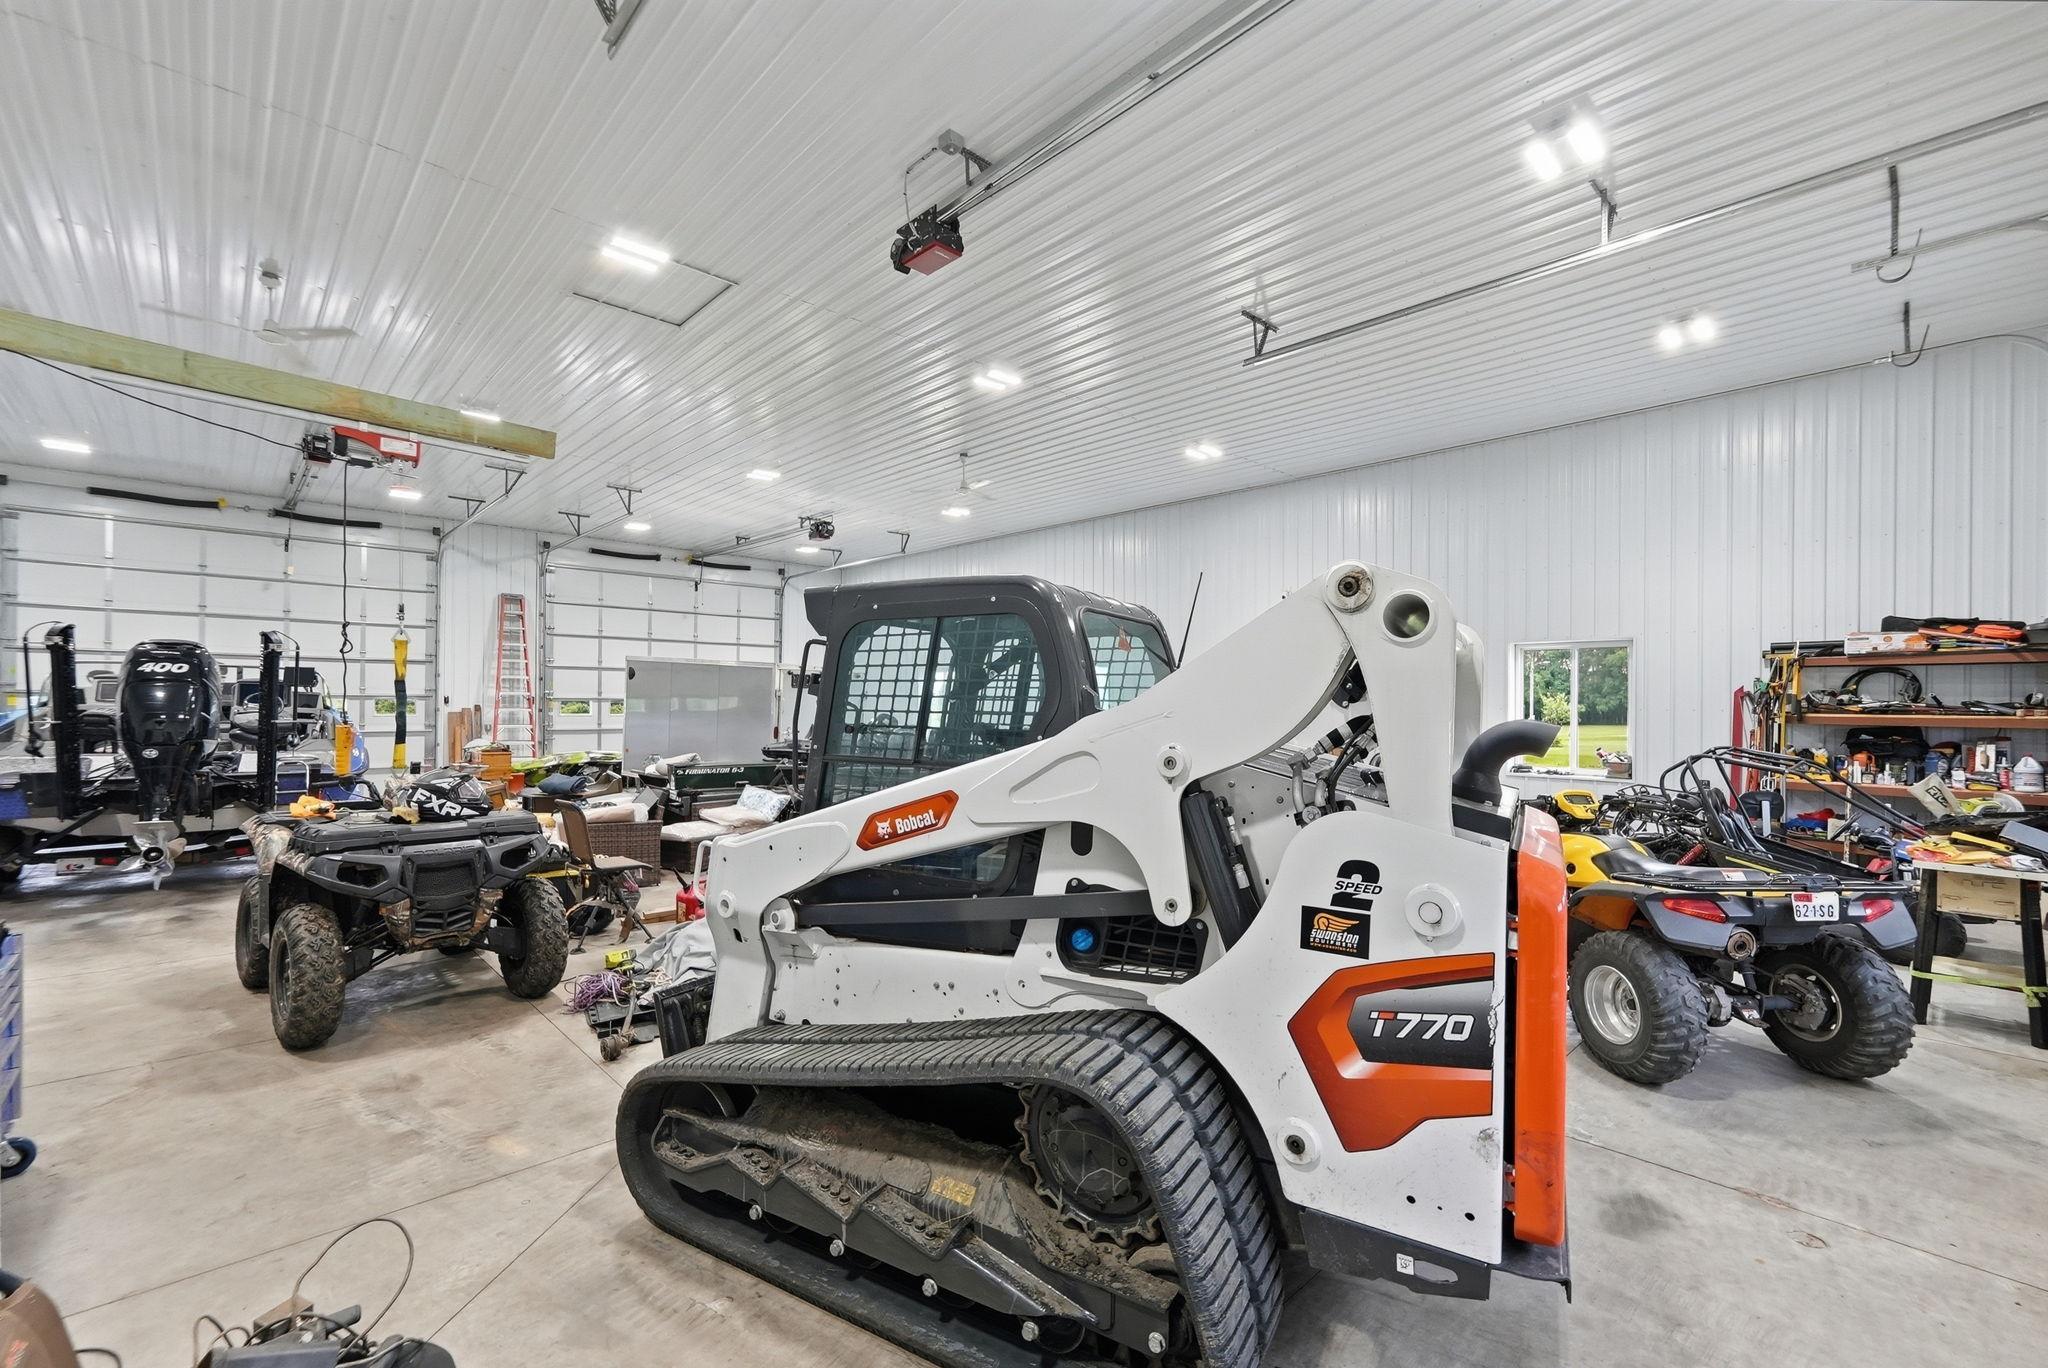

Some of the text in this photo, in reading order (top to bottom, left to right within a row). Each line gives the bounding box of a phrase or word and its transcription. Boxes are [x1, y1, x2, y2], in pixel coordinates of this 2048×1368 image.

[137, 662, 190, 674] 400
[410, 787, 462, 817] FXR
[895, 808, 937, 834] Bobcat
[1330, 859, 1381, 911] 2
[1334, 880, 1383, 895] SPEED
[1369, 1011, 1476, 1042] T770
